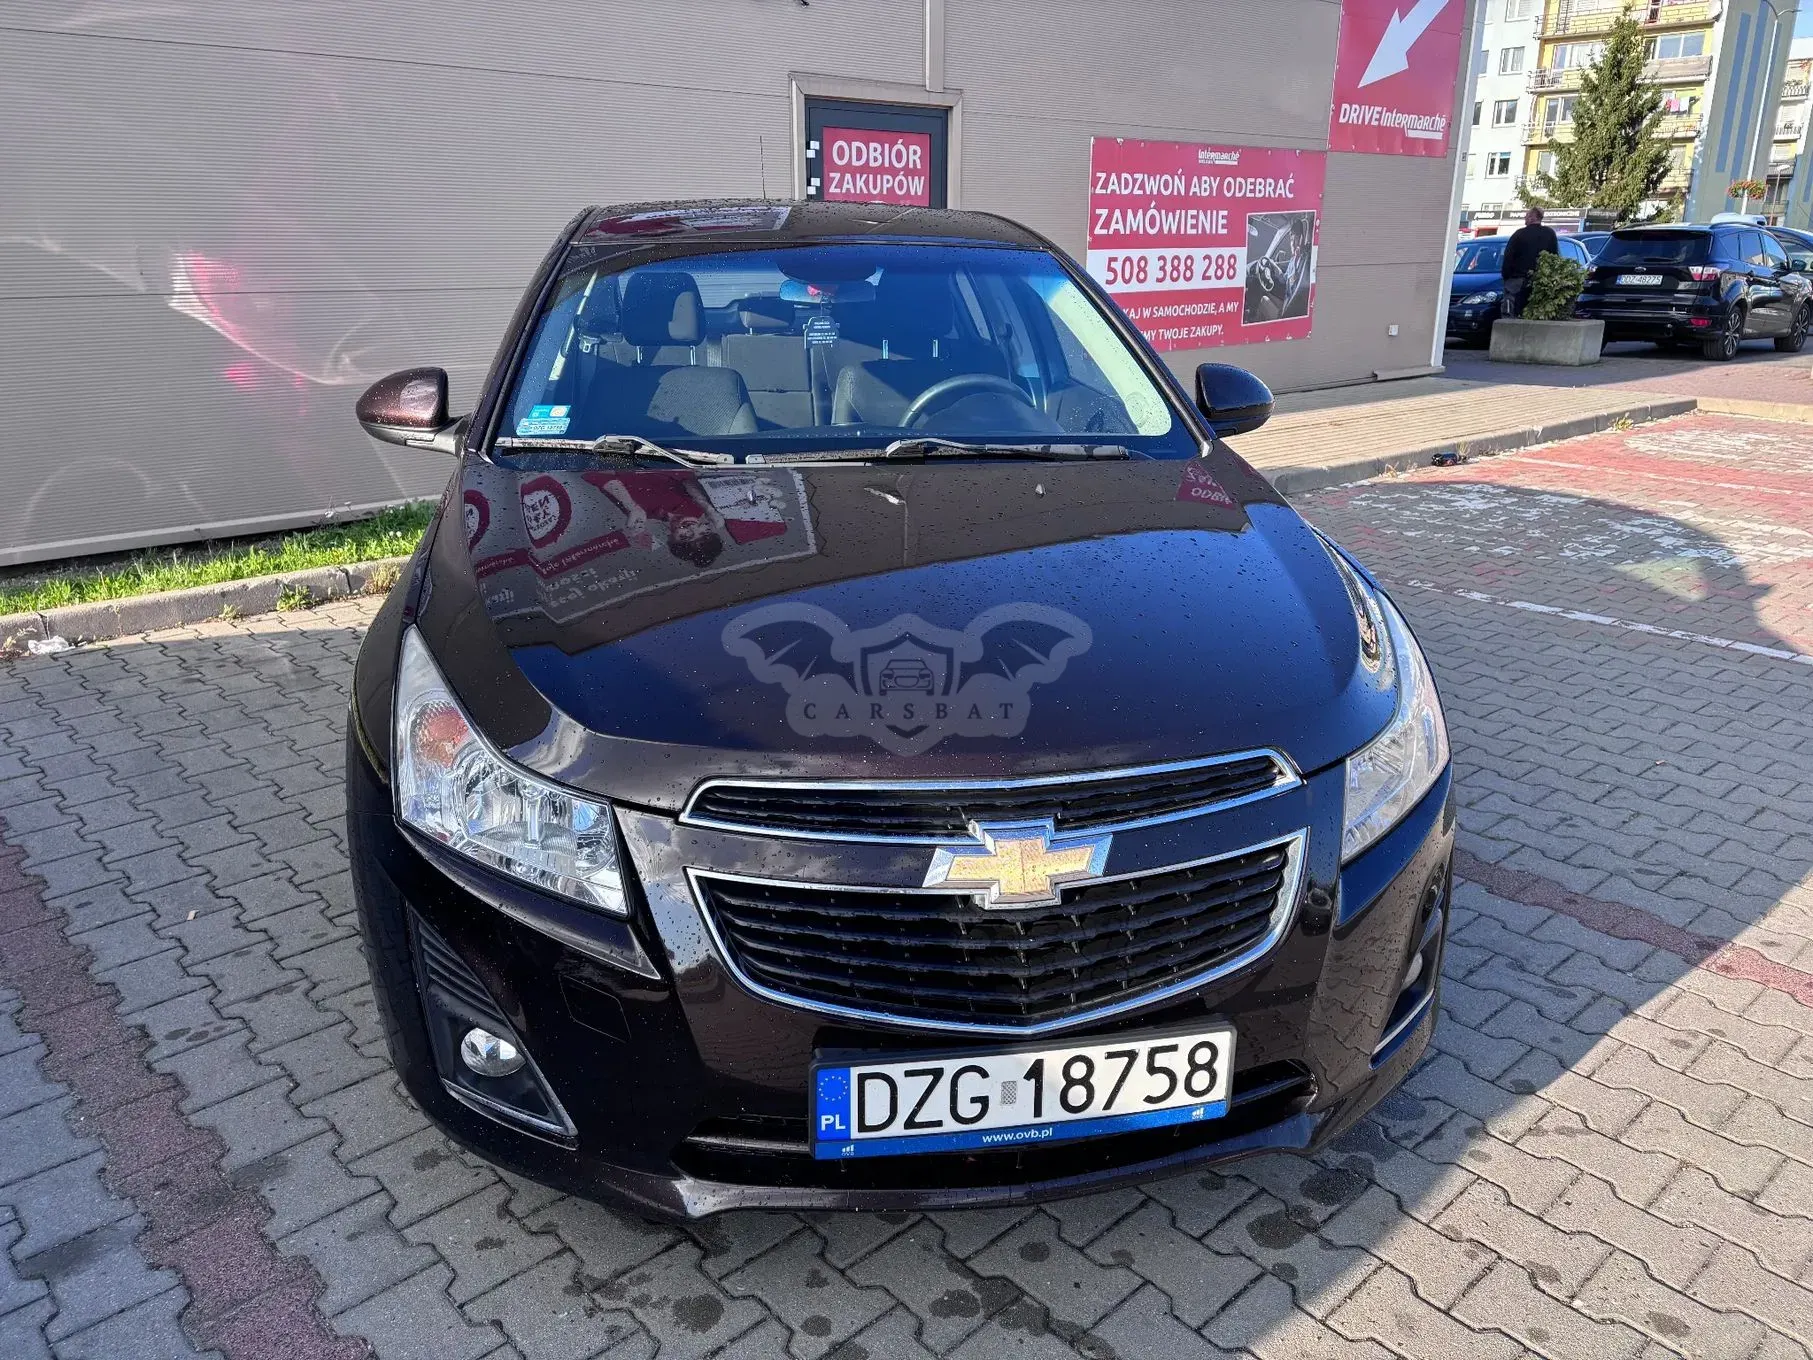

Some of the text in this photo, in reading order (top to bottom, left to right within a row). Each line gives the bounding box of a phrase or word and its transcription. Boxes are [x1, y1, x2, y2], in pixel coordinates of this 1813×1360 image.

[1339, 103, 1447, 136] DRIVE Intermarché
[832, 138, 922, 169] ODBIÓR
[829, 171, 925, 196] ZAKUPÓW
[1095, 168, 1295, 198] ZADZWOŃ ABY ODEBRAĆ
[1093, 201, 1228, 235] ZAMÓWIENIE
[1105, 254, 1237, 286] 508 388 288
[1142, 308, 1151, 318] W
[1153, 303, 1217, 318] SAMOCHODZIE,
[1218, 304, 1225, 313] A
[1226, 302, 1239, 312] MY
[1158, 327, 1189, 340] TWOJE
[1190, 324, 1224, 337] ZAKUPY.
[857, 1040, 1220, 1134] DZG 18758
[821, 1115, 846, 1131] PL
[982, 1128, 1053, 1145] www.ovb.pl
